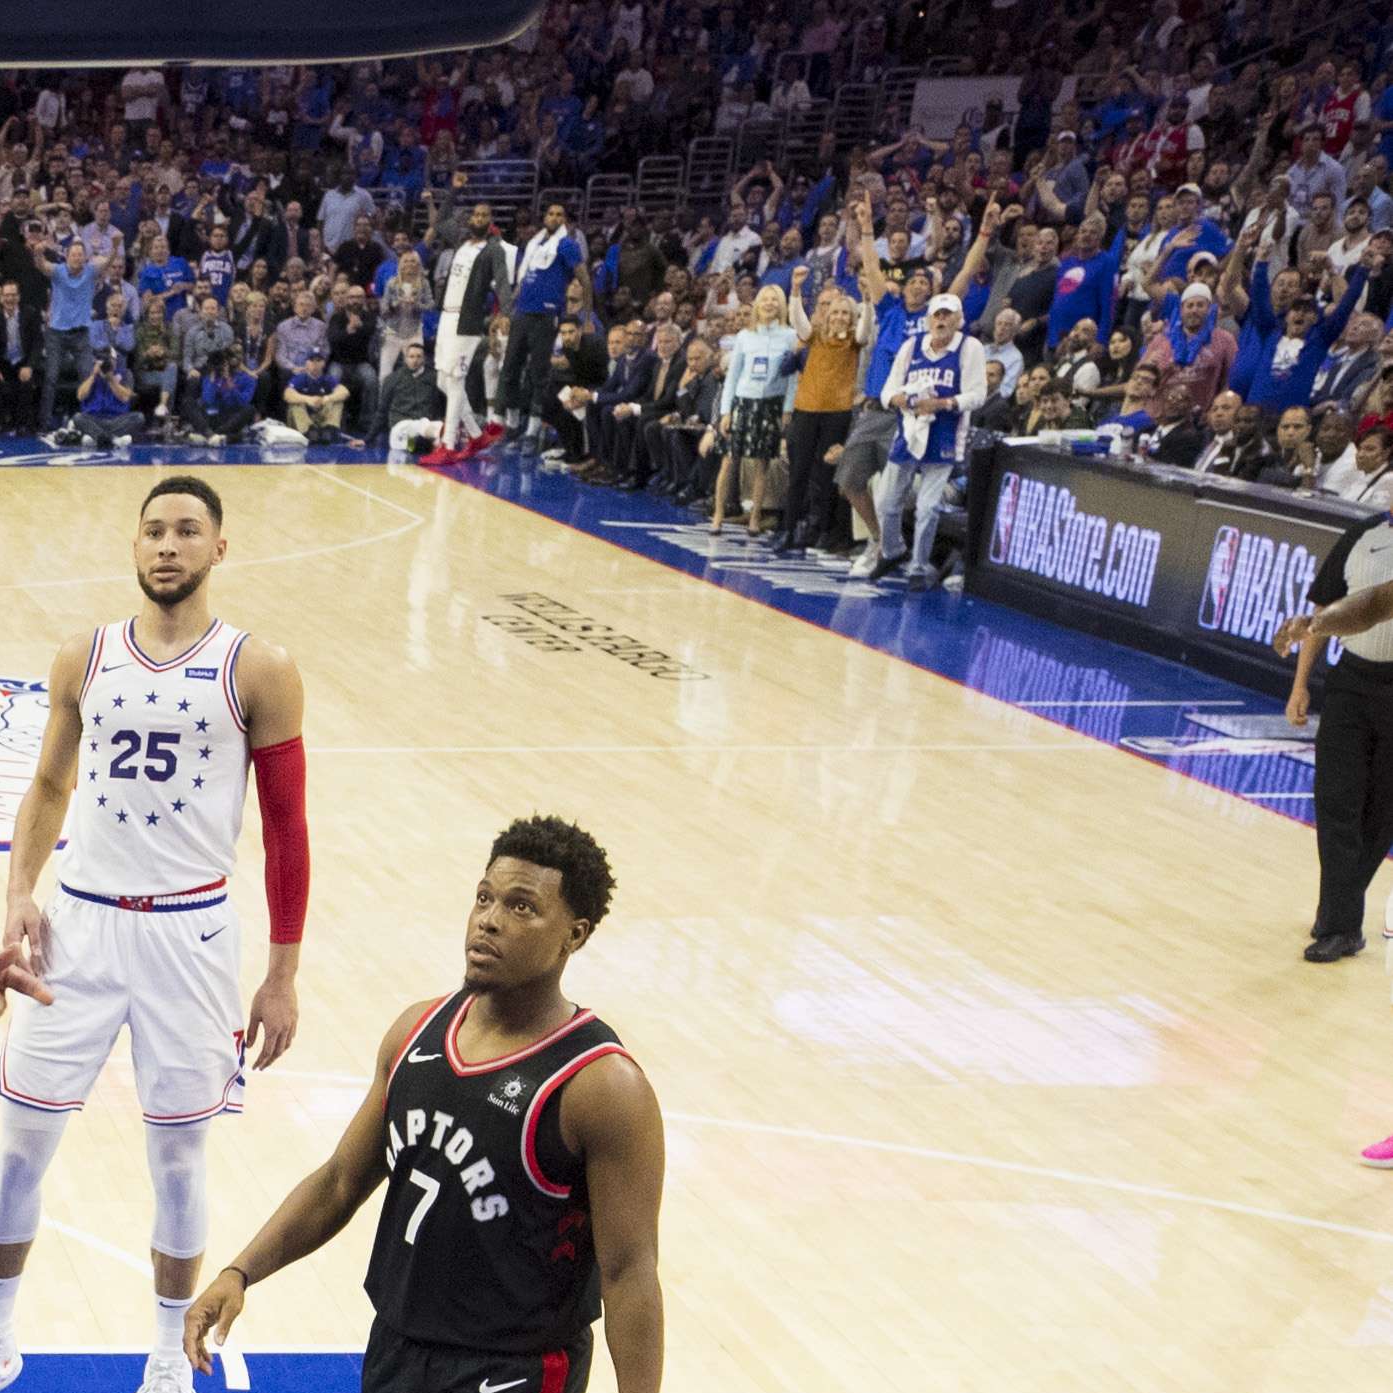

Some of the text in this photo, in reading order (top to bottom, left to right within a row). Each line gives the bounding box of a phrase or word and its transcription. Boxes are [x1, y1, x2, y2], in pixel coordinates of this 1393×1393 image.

[1007, 478, 1161, 608] NBAStore.com
[110, 729, 181, 782] 25
[404, 1168, 441, 1246] 7
